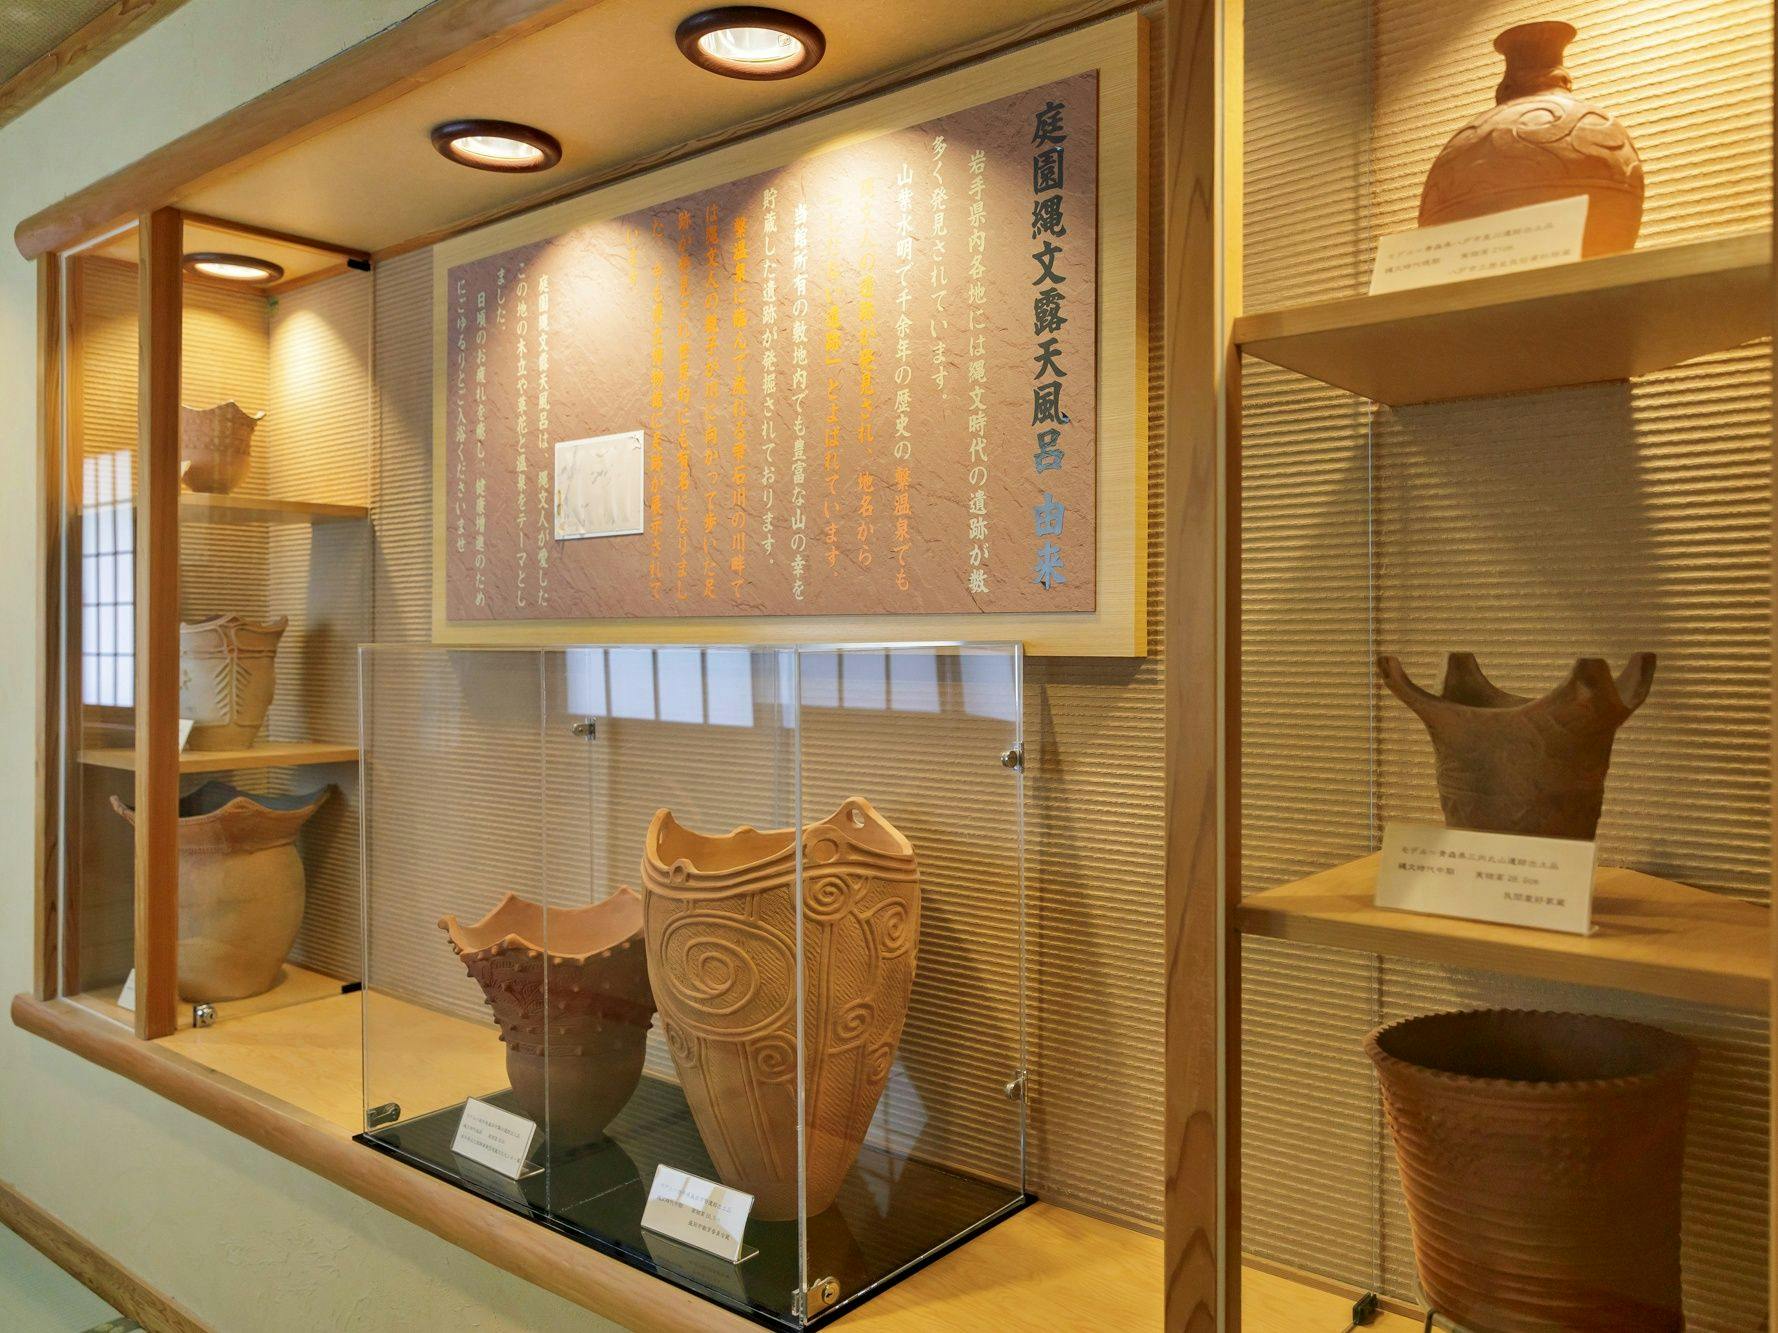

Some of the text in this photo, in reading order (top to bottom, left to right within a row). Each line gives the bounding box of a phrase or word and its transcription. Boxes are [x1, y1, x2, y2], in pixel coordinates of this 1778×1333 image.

[761, 188, 778, 564] 貯蔵した遺跡が発掘されております。
[930, 135, 949, 400] 多く発見されています。
[968, 150, 990, 593] 岩手県内各地には縄文時代の遺跡が数
[1031, 101, 1072, 590] 庭園縄文露天風呂 由来
